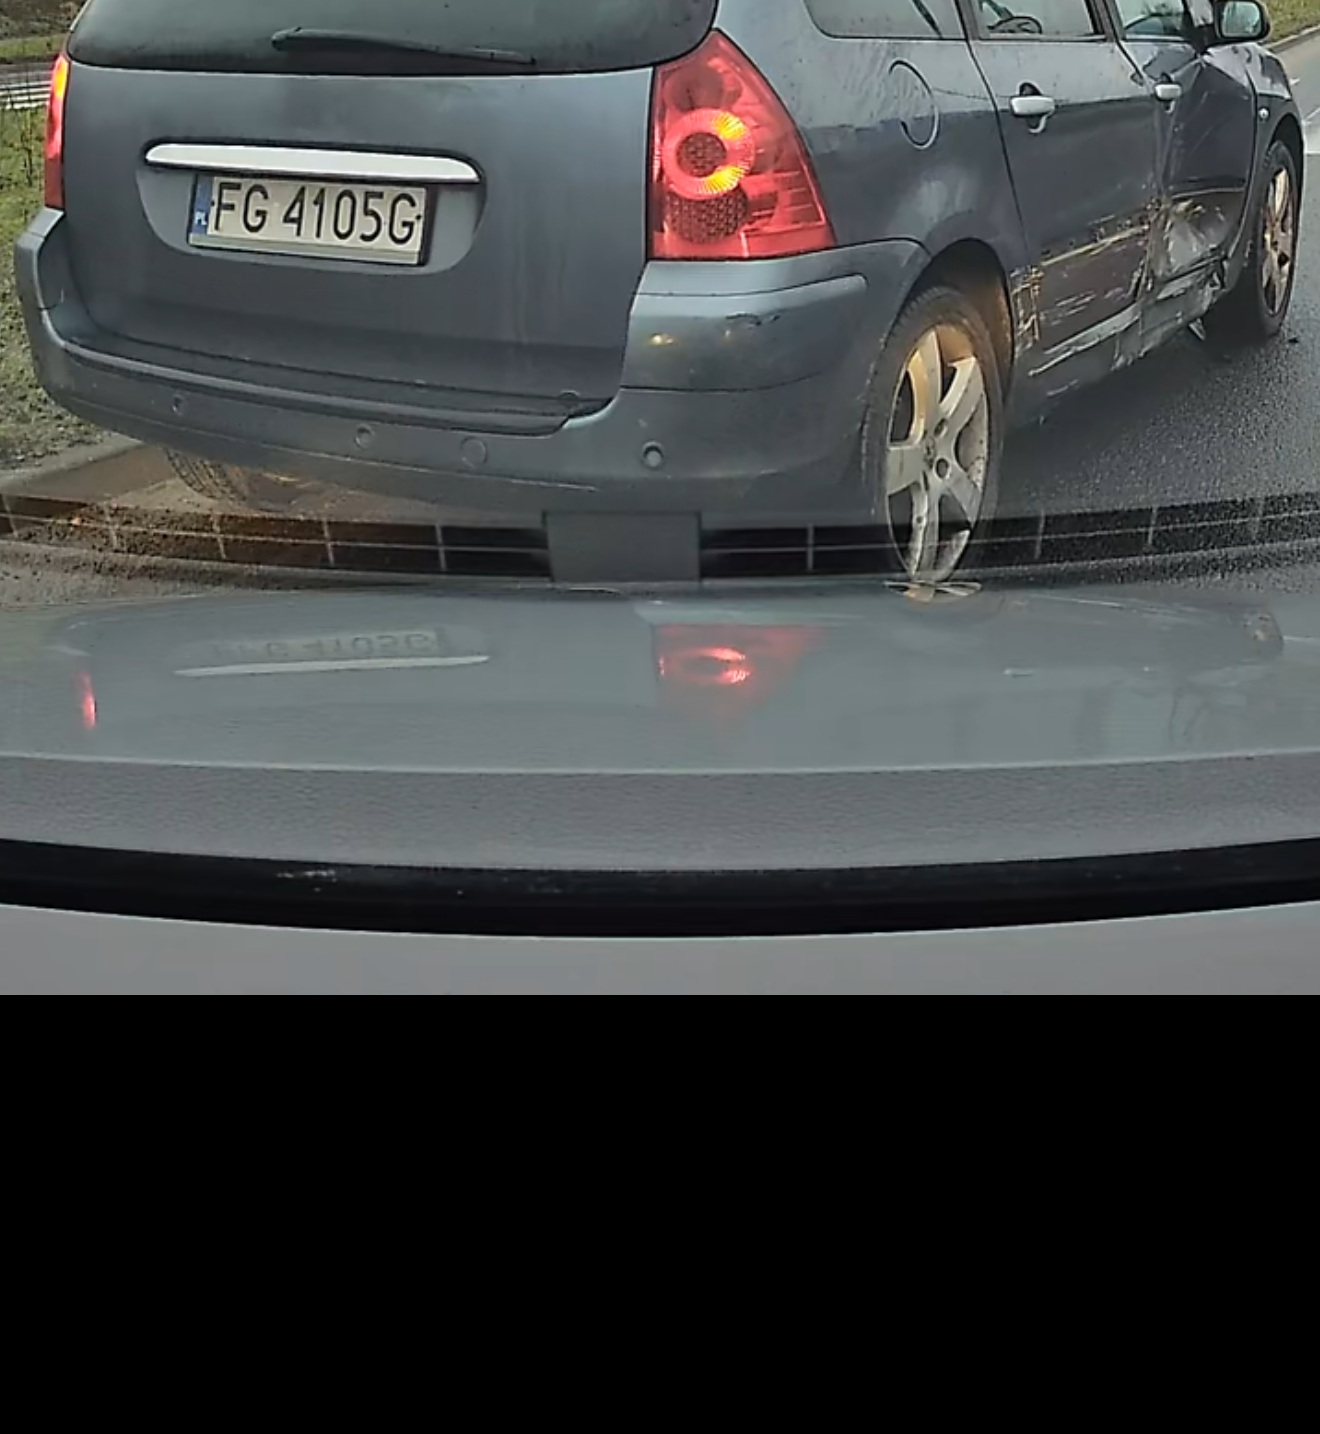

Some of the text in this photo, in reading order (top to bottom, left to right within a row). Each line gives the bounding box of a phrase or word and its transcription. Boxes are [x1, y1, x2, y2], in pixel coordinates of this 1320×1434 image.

[194, 211, 208, 226] PL
[214, 182, 417, 245] FG 4105G
